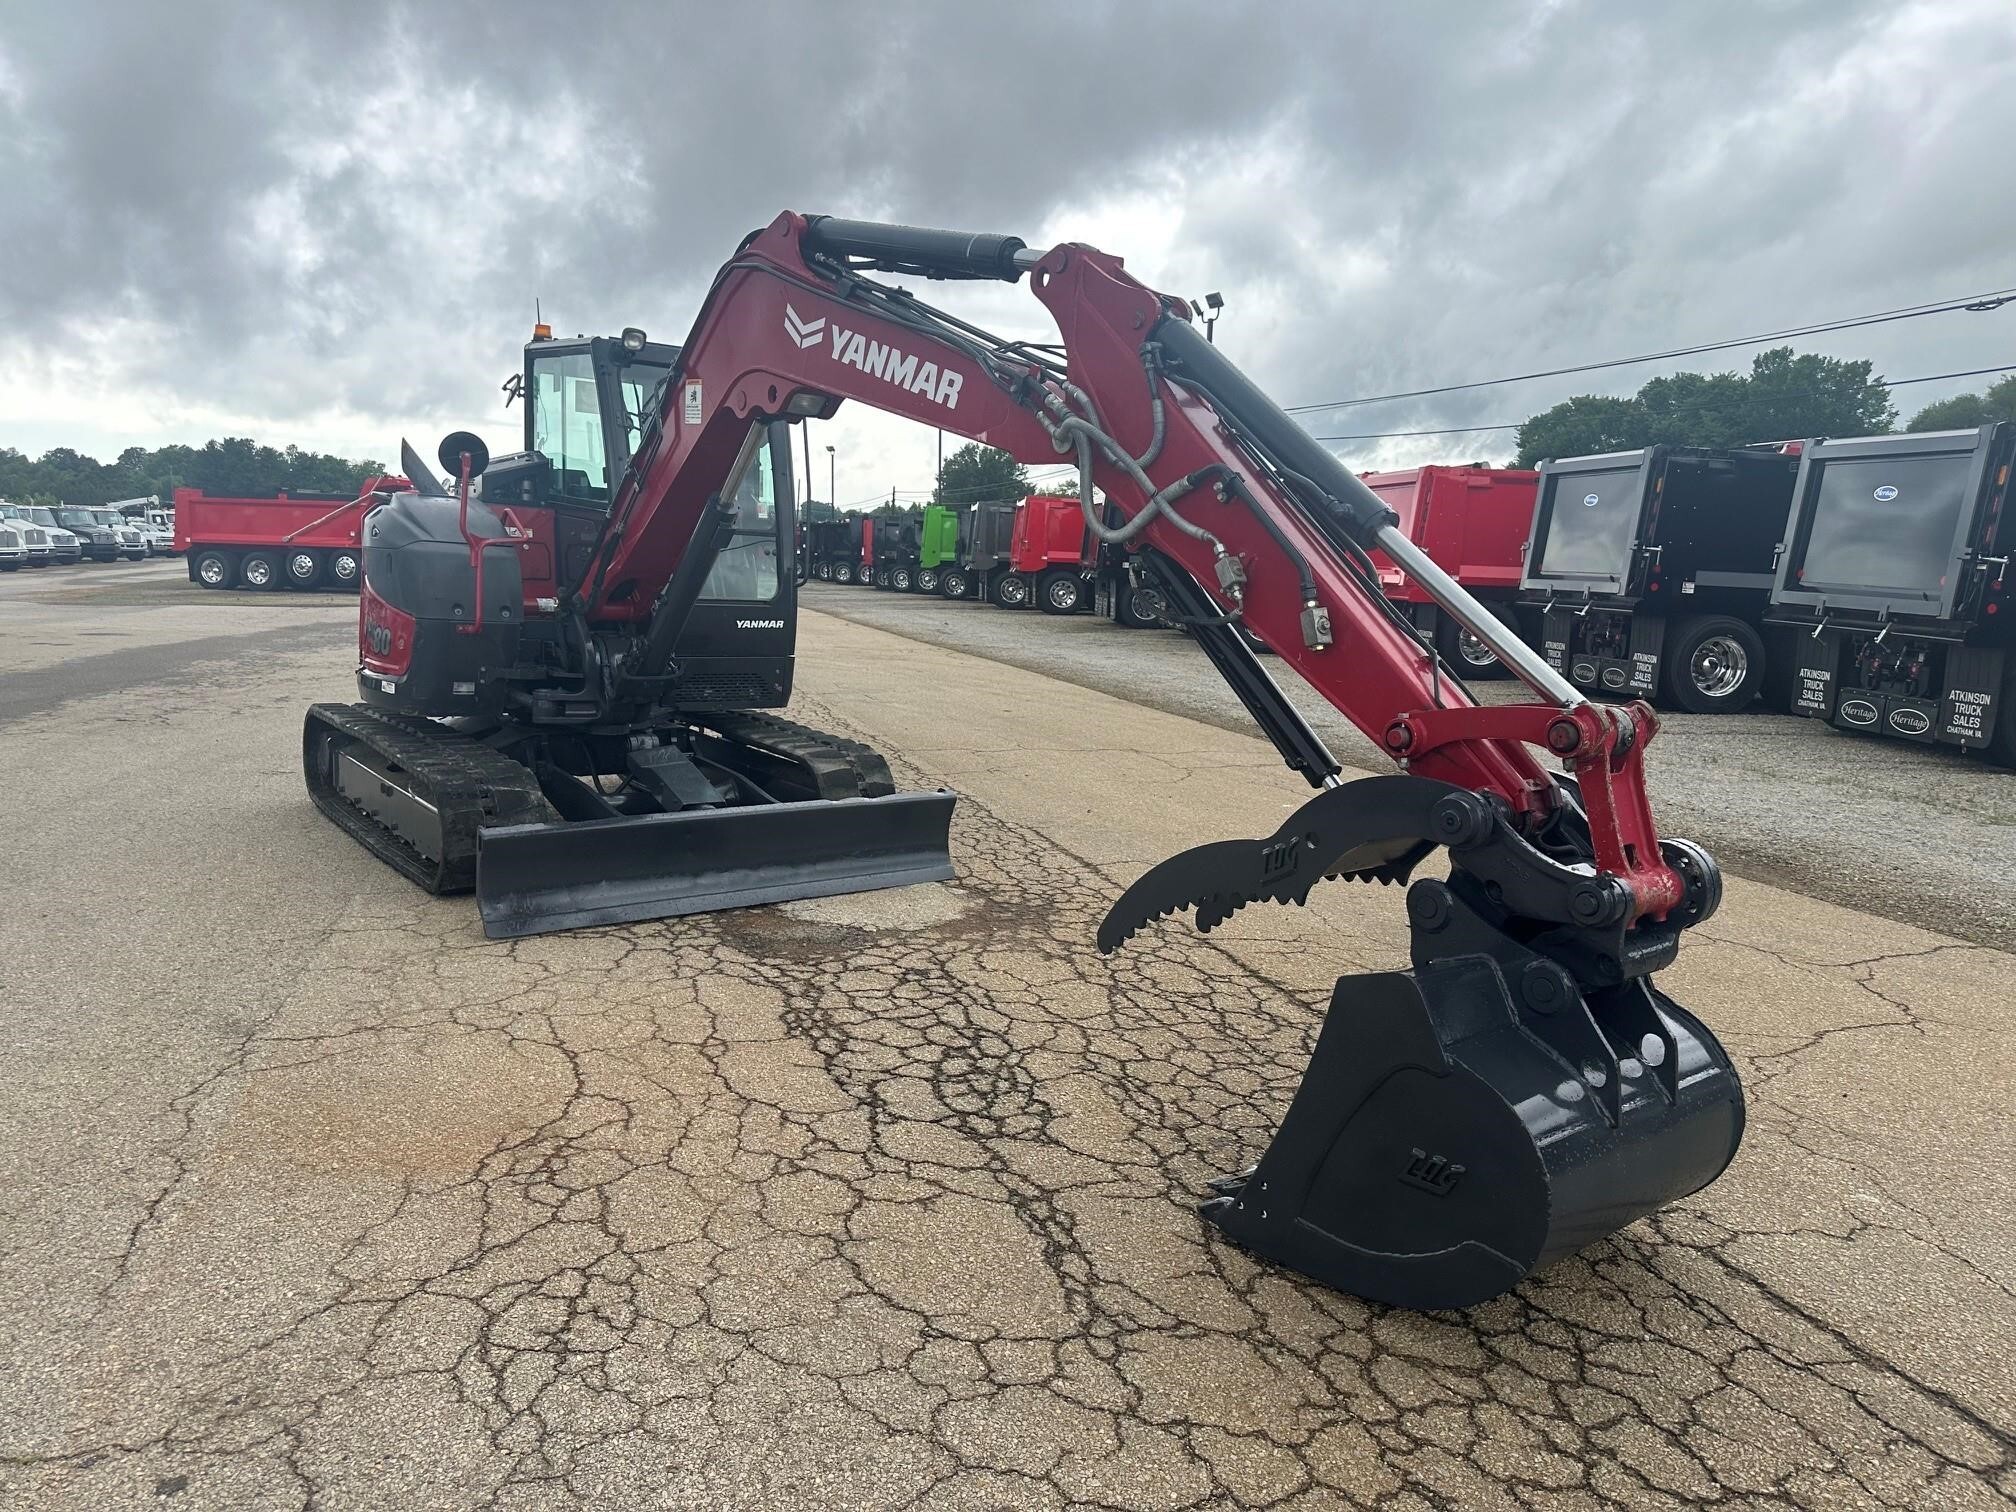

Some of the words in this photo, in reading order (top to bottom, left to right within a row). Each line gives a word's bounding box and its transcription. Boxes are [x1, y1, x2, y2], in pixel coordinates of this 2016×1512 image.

[832, 324, 963, 409] YANMAR
[736, 620, 784, 629] YANMAR
[1633, 652, 1657, 663] ATKINSON
[1636, 662, 1652, 672] TRUCK
[1634, 671, 1652, 682] SALES
[1799, 668, 1830, 681] ATKINSON
[1803, 679, 1824, 690] TRUCK
[1802, 690, 1823, 701] SALES
[1949, 689, 1991, 705] ATKINSON
[1842, 705, 1876, 720] Heritage
[1955, 702, 1982, 716] TRUCK
[1892, 713, 1927, 730] Heritage
[1953, 714, 1981, 728] SALES
[1974, 730, 1982, 738] VA
